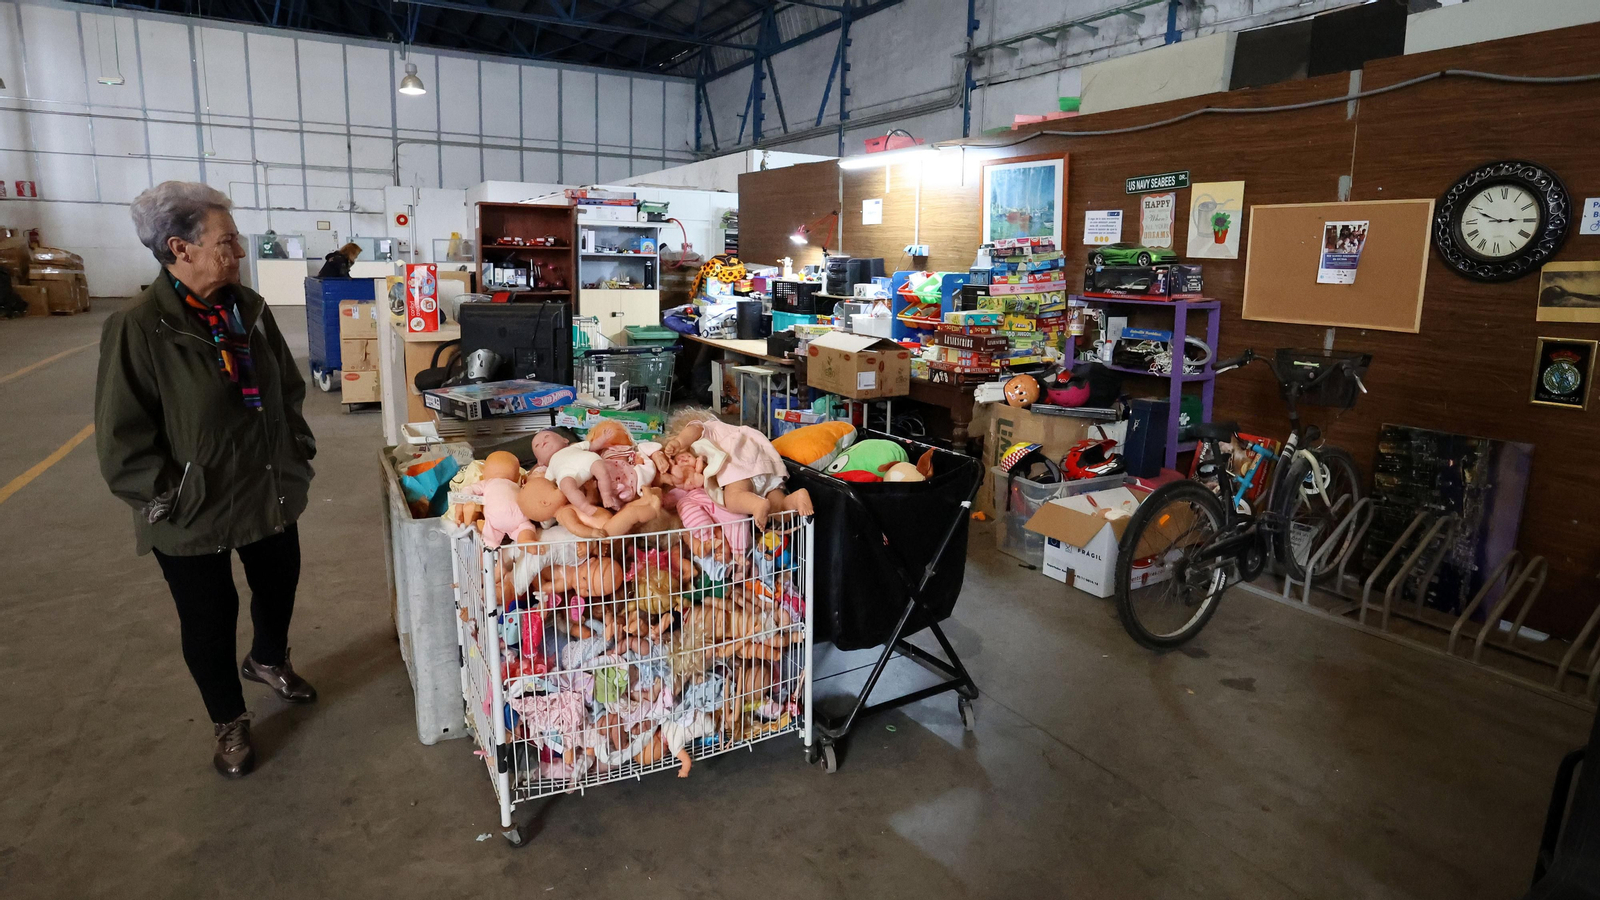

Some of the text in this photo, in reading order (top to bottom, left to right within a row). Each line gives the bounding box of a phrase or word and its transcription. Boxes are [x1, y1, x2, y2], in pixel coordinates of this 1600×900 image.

[1128, 181, 1136, 191] US
[1136, 179, 1150, 190] NAVY
[1150, 175, 1176, 188] SEABEES
[1144, 199, 1171, 209] HAPPY
[1143, 231, 1170, 239] DREAMS
